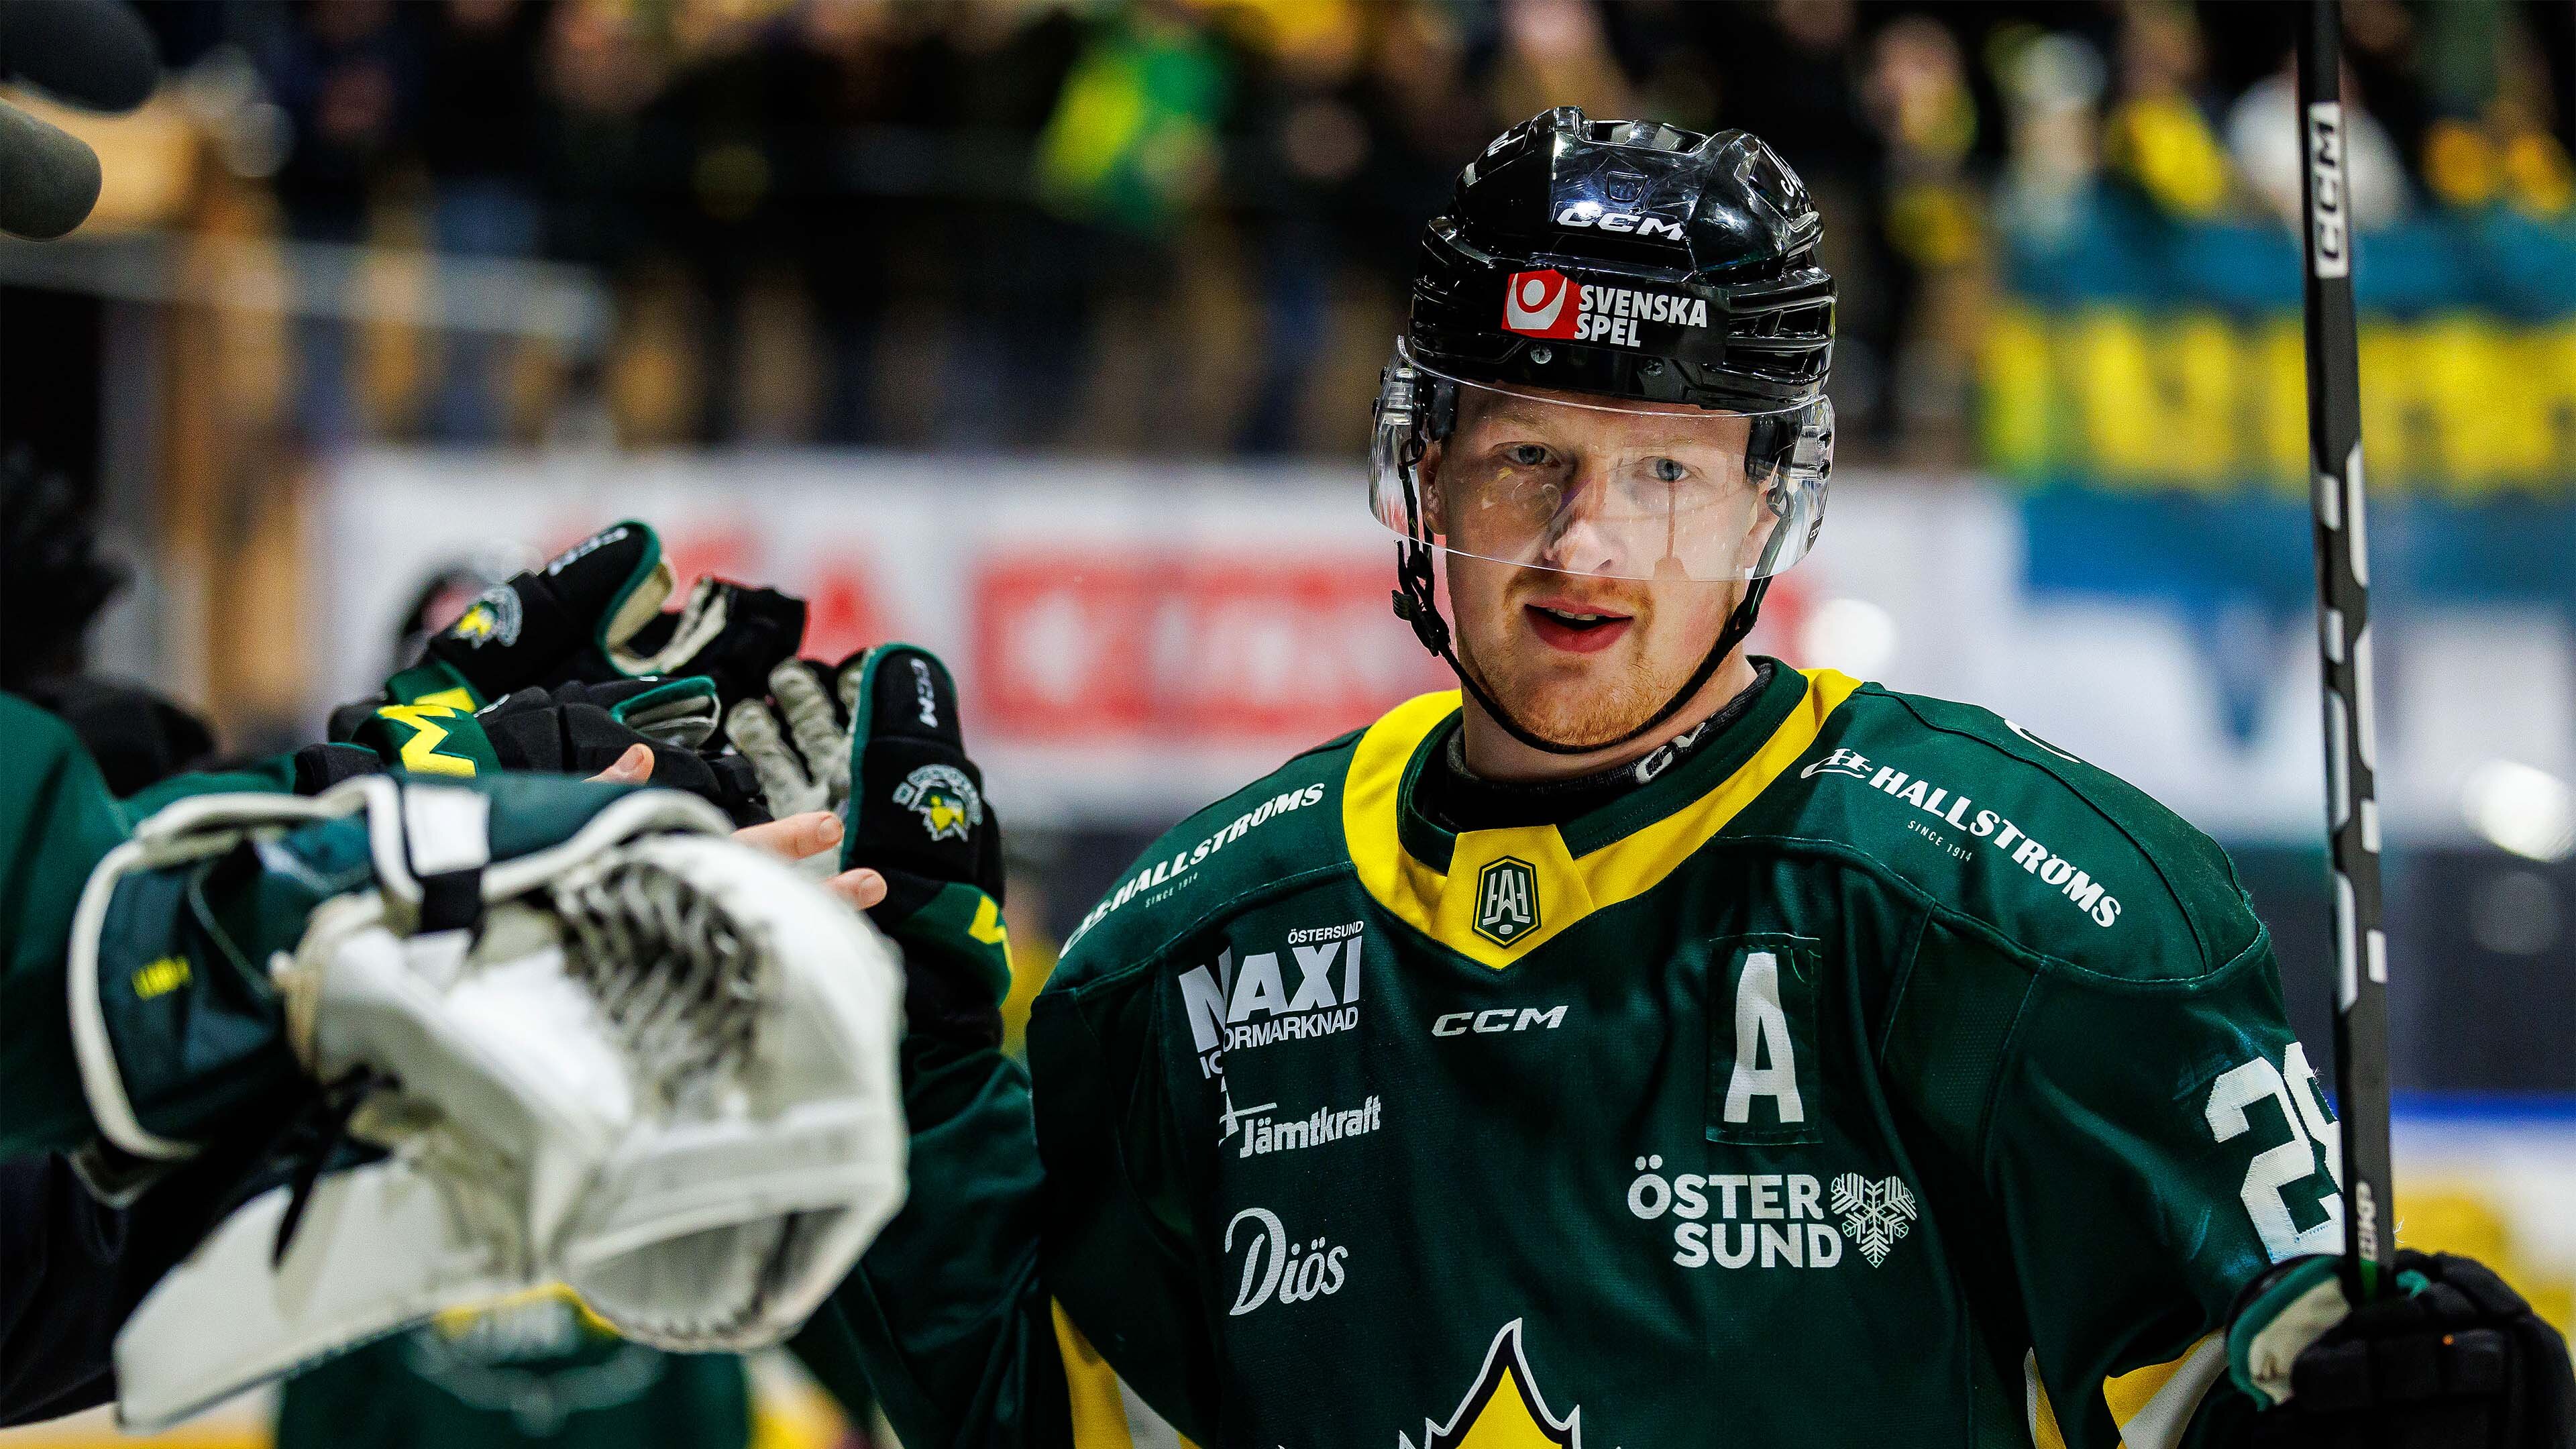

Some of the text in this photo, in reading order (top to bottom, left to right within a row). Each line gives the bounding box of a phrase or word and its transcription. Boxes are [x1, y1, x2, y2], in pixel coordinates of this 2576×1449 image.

[2316, 119, 2341, 260] CCM
[1556, 207, 1684, 241] CCM
[1574, 312, 1641, 348] SPEL
[1578, 284, 1708, 328] SVENSKA
[1108, 782, 1326, 912] HALLSTRÖMS
[1868, 765, 2123, 928] HALLSTRÖMS
[1907, 820, 1972, 863] SINCE 1914
[1287, 920, 1364, 944] ÖSTERSUND
[1431, 1006, 1569, 1037] CCM
[1723, 951, 1805, 1124] A
[1240, 1095, 1382, 1159] Jämtkraft
[1627, 1154, 1825, 1220] ÖSTER
[1224, 1208, 1348, 1316] Diös
[1672, 1222, 1842, 1269] SUND
